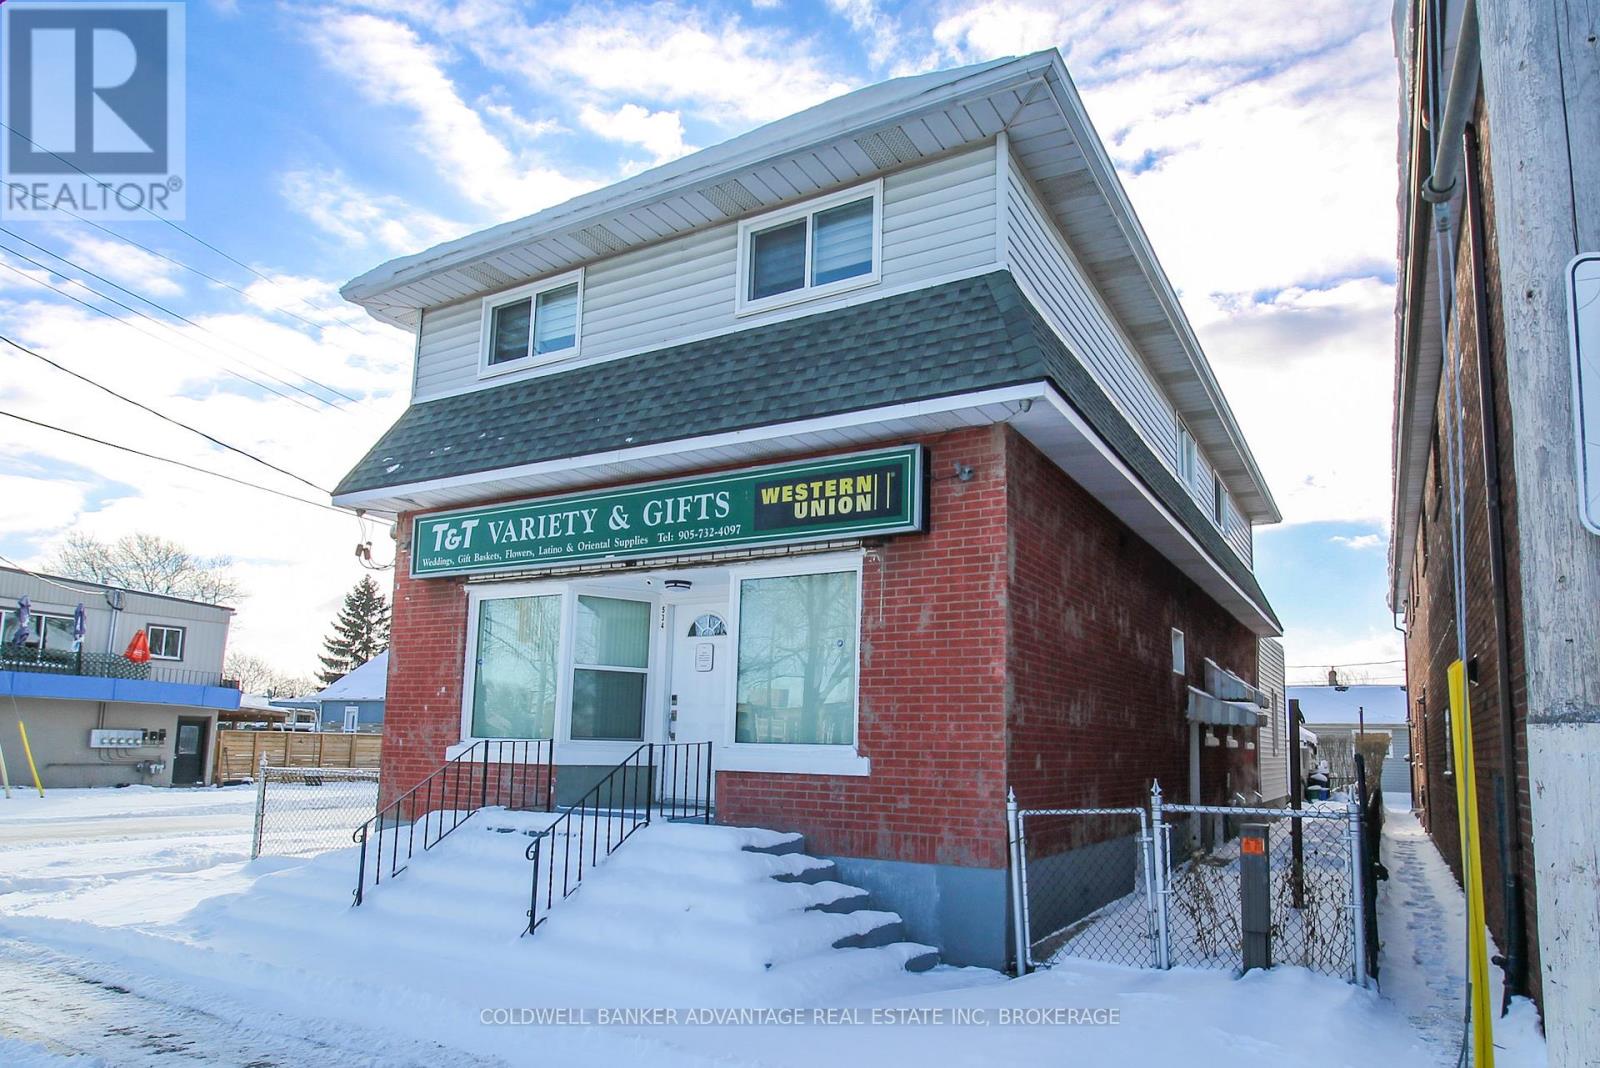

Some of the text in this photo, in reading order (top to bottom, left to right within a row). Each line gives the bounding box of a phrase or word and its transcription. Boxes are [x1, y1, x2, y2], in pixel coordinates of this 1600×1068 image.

[761, 474, 872, 505] WESTERN
[794, 493, 872, 519] UNION
[432, 491, 730, 552] T&T VARIETY & GIFTS
[457, 553, 471, 564] Gift
[474, 552, 502, 562] Baskets,
[505, 549, 535, 559] Flowers,
[538, 545, 563, 555] Latino
[566, 542, 574, 552] &
[577, 538, 610, 551] Oriental
[614, 535, 649, 548] Supplies
[657, 531, 674, 543] Tel:
[678, 524, 741, 541] 905-732-4097
